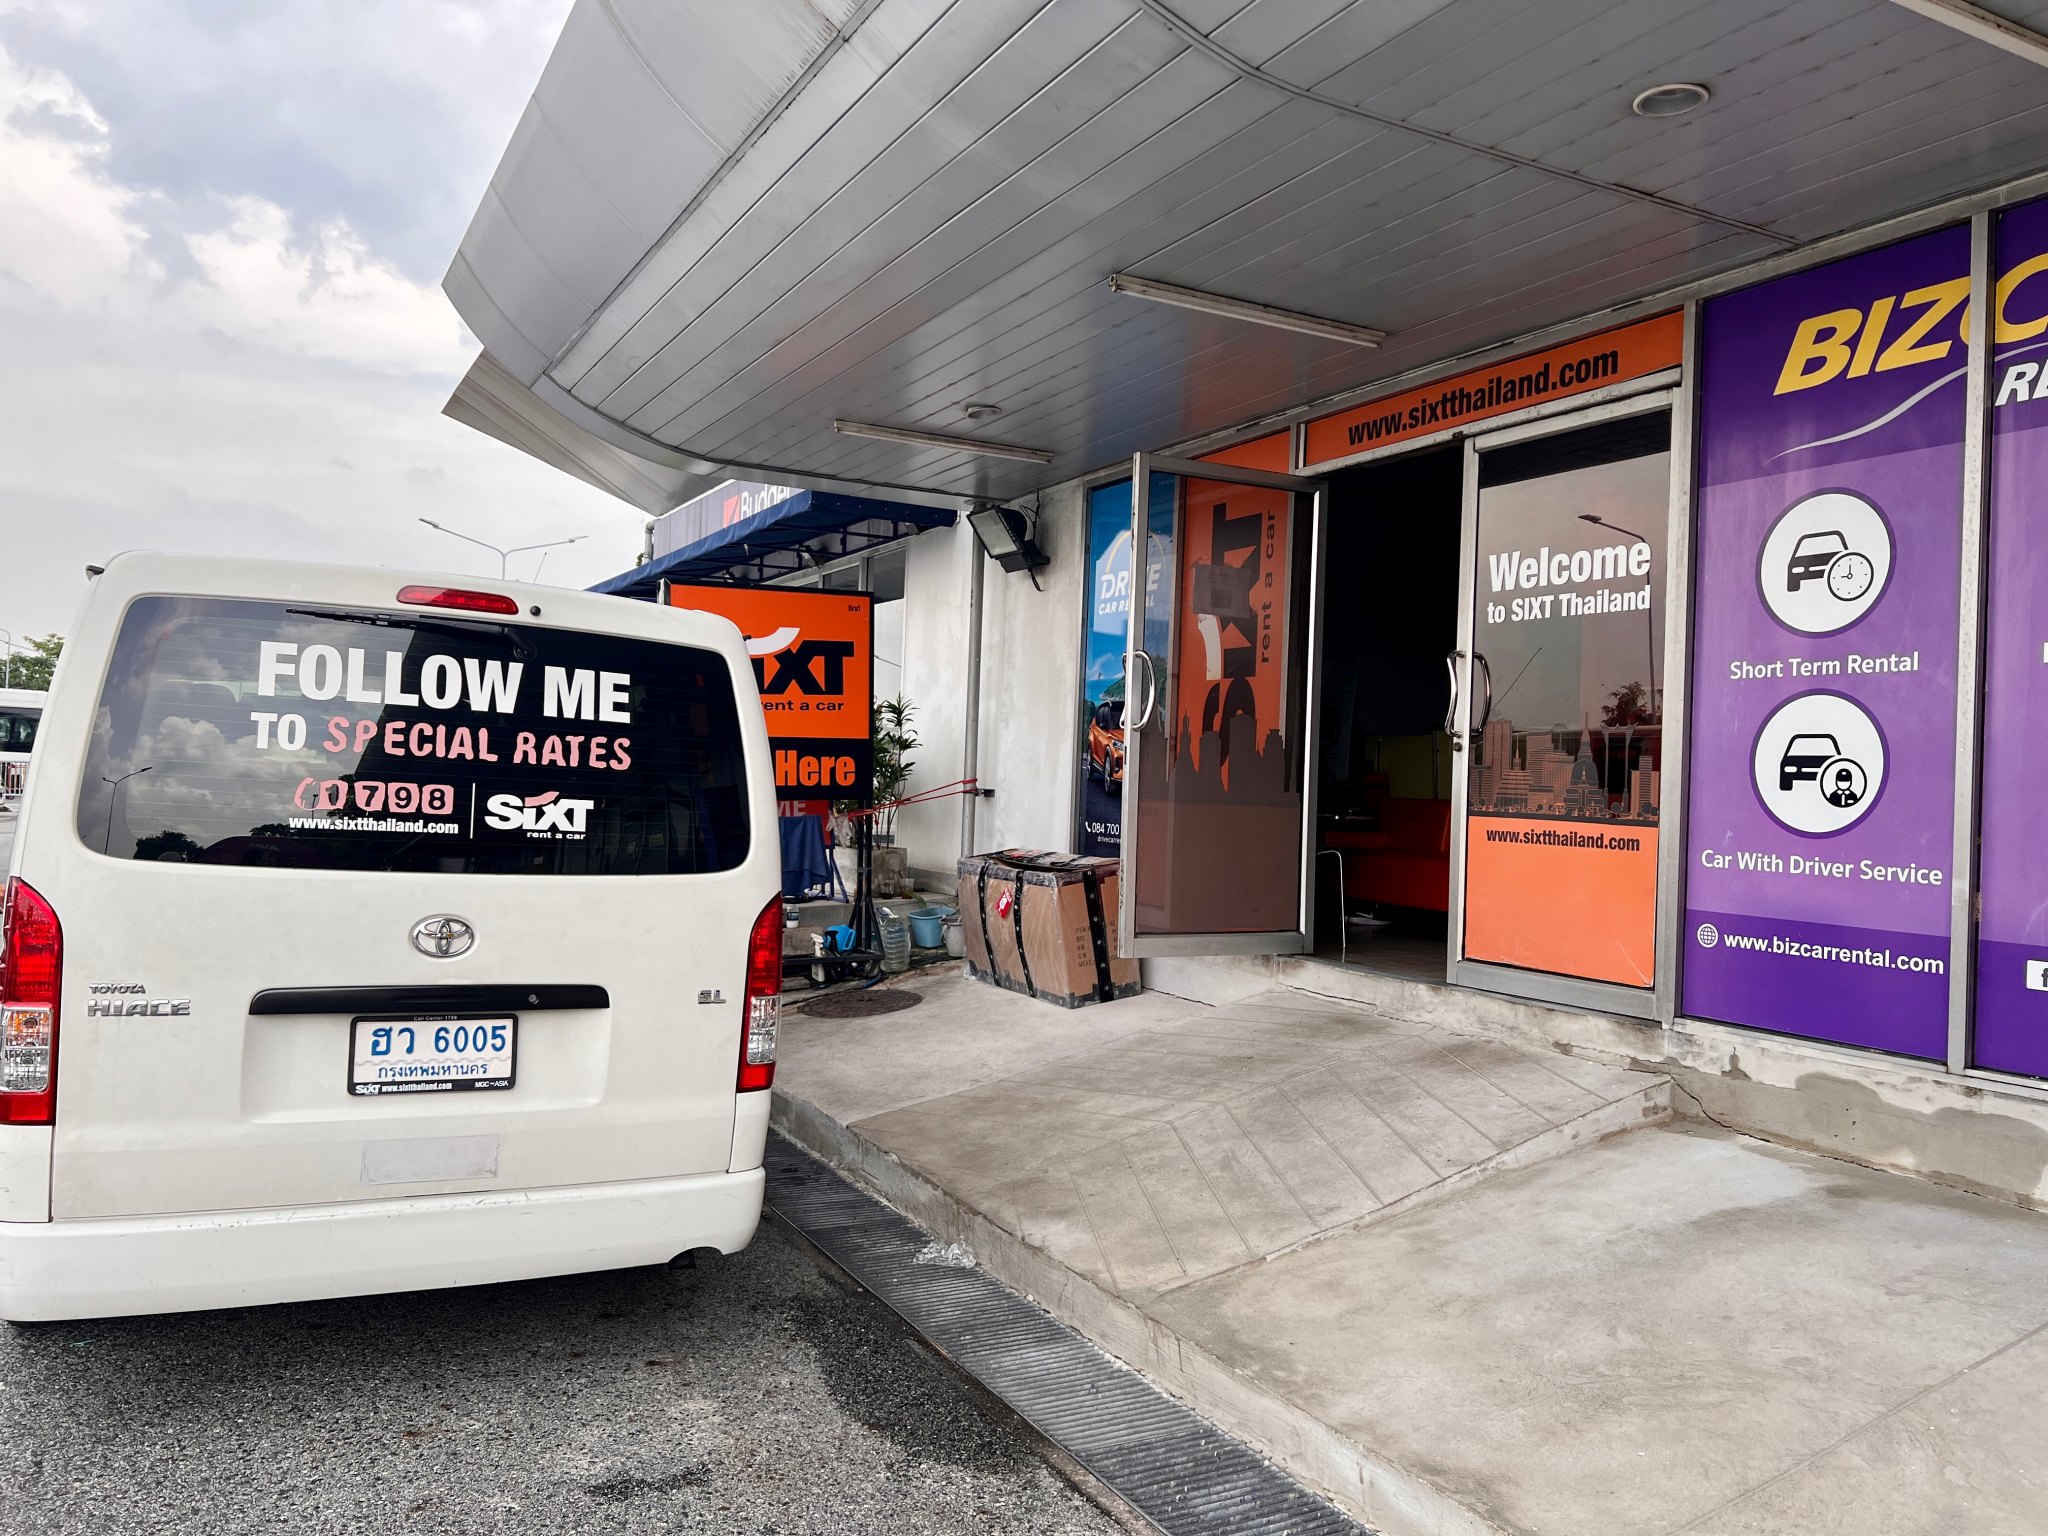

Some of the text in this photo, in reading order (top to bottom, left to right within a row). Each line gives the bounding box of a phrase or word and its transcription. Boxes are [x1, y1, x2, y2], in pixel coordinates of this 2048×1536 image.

[1347, 349, 1619, 447] www.sixtthailand.com
[1488, 542, 1651, 593] Welcome
[1261, 510, 1276, 663] rent a car
[1098, 601, 1117, 615] CAR
[1487, 585, 1651, 624] to SIXT Thailand
[1729, 651, 1920, 680] Short Term Rental
[256, 640, 631, 724] FOLLOW ME
[762, 701, 844, 711] ent a car
[250, 711, 632, 771] TO SPECIAL RATES
[775, 750, 856, 787] Here
[289, 816, 459, 834] www.sixtthailand.com
[1092, 822, 1120, 835] 084 700
[1486, 828, 1641, 852] www.sixtthailand.com
[1701, 849, 1944, 886] Car With Driver Service
[1723, 932, 1945, 975] www.bizcarrental.com
[89, 983, 146, 994] TOYOTA
[87, 999, 191, 1017] HIACE
[434, 1025, 507, 1053] 6005
[378, 1063, 488, 1082] กรุงเทพมหานคร
[381, 1083, 453, 1093] www.sixtthailand.com
